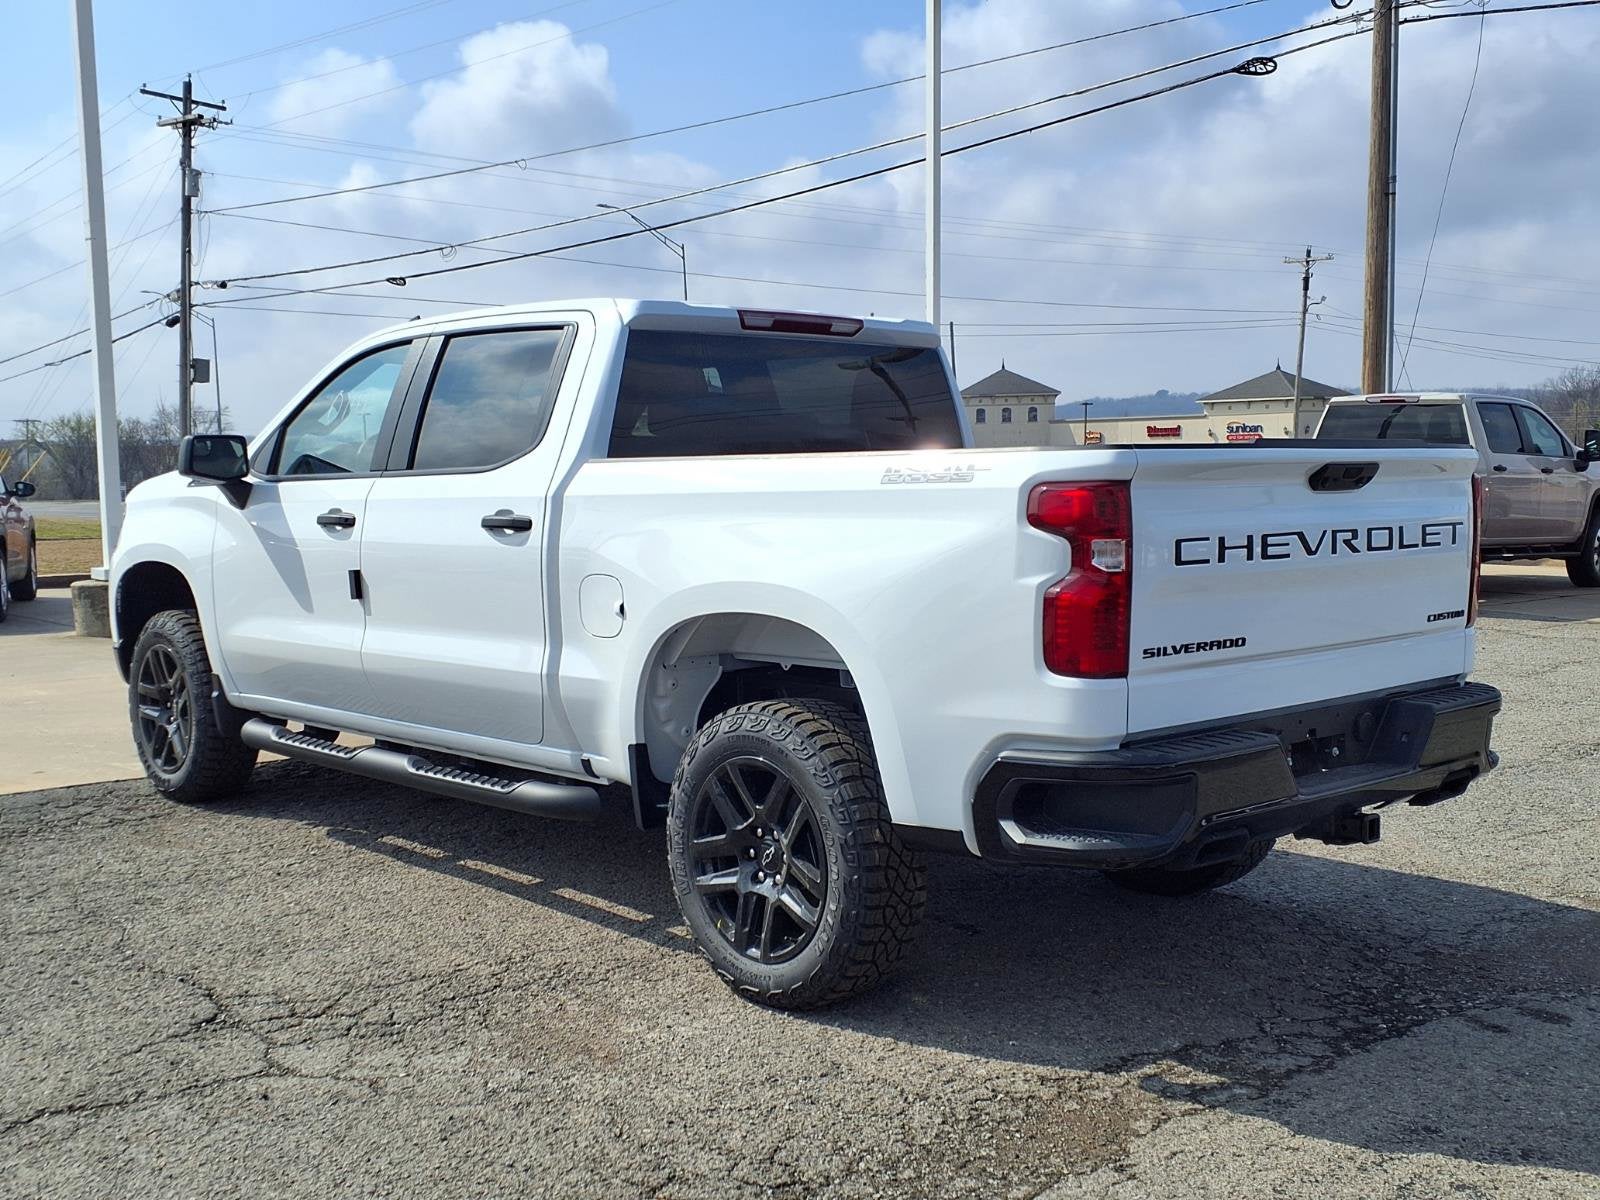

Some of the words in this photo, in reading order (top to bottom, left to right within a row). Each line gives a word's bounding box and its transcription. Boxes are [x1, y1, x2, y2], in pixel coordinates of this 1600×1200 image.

[1175, 521, 1464, 566] CHEVROLET
[1426, 610, 1465, 622] CUSTOM
[1142, 637, 1246, 659] SILVERADO
